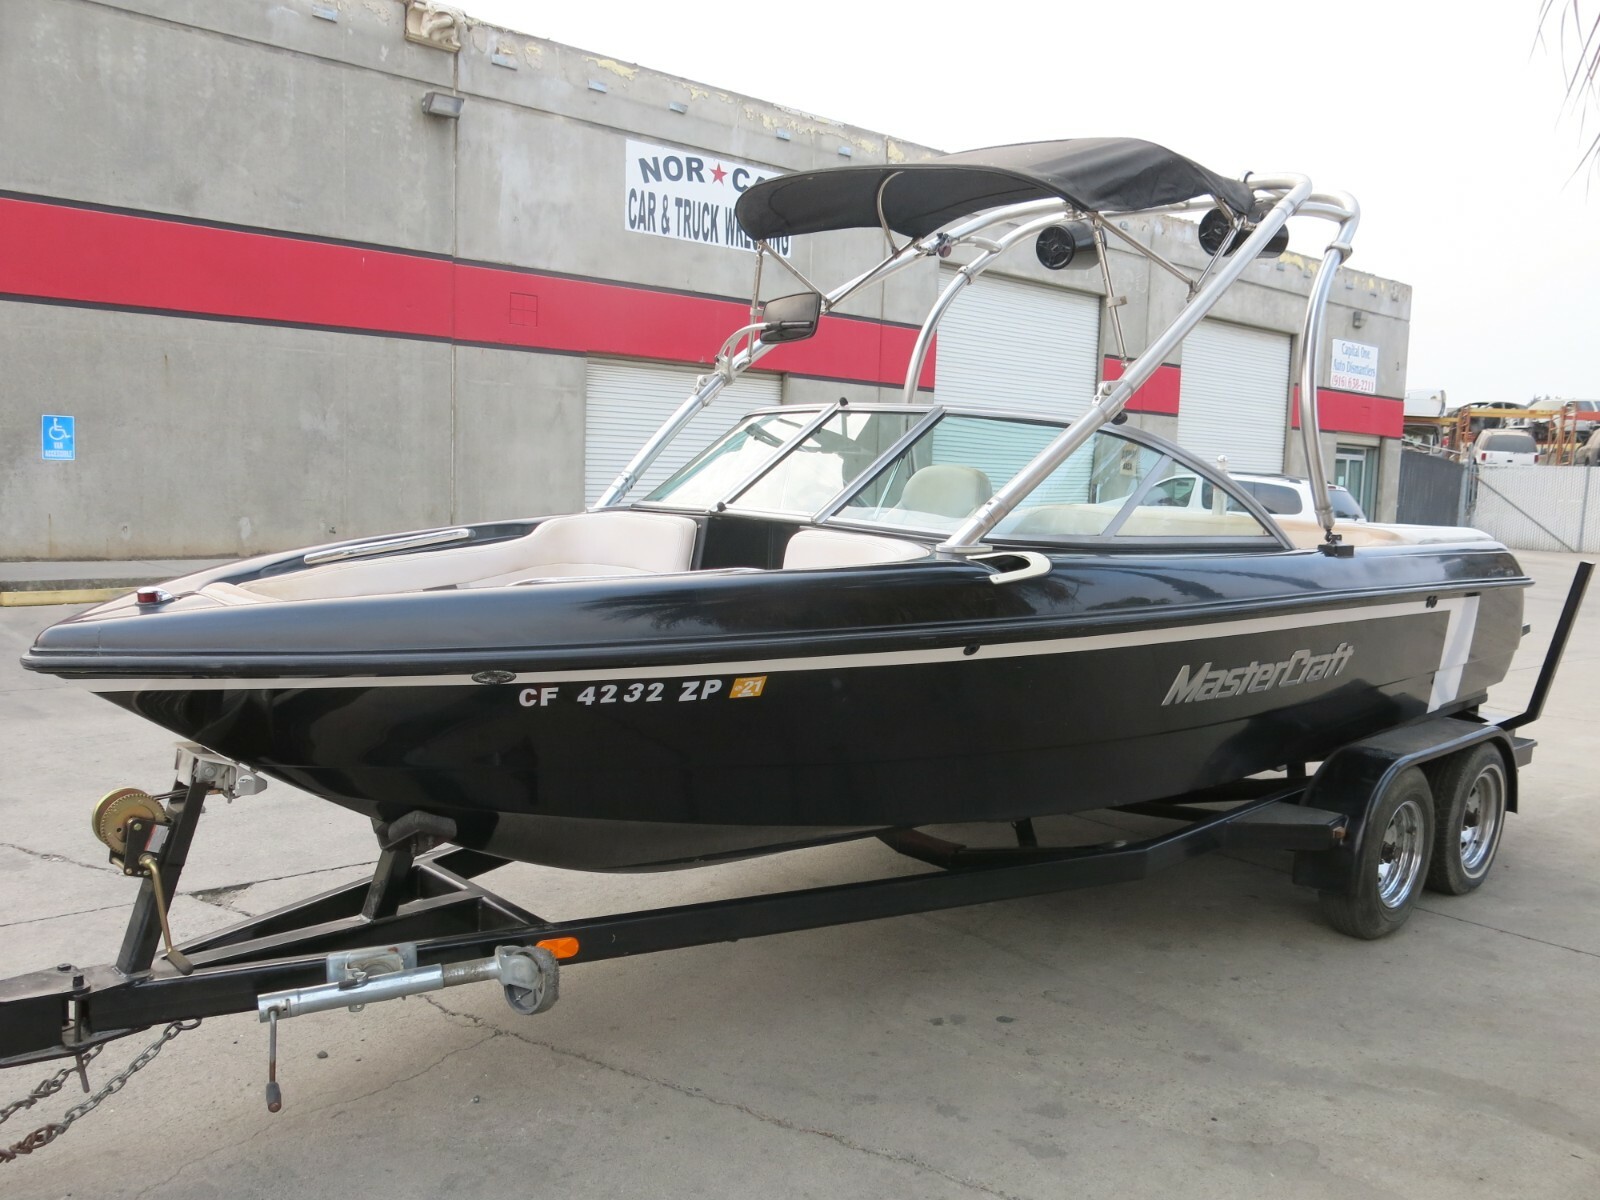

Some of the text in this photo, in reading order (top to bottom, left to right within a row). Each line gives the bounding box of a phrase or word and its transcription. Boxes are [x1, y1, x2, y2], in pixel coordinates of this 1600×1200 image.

[638, 155, 706, 184] NOR
[628, 187, 656, 233] CAR
[661, 193, 670, 235] &
[674, 196, 719, 244] TRUCK
[1333, 358, 1346, 372] Auto
[1342, 342, 1371, 360] Capital One
[742, 680, 762, 693] 21
[1161, 642, 1354, 706] MasterCraft
[518, 678, 723, 707] CF 4232 ZP
